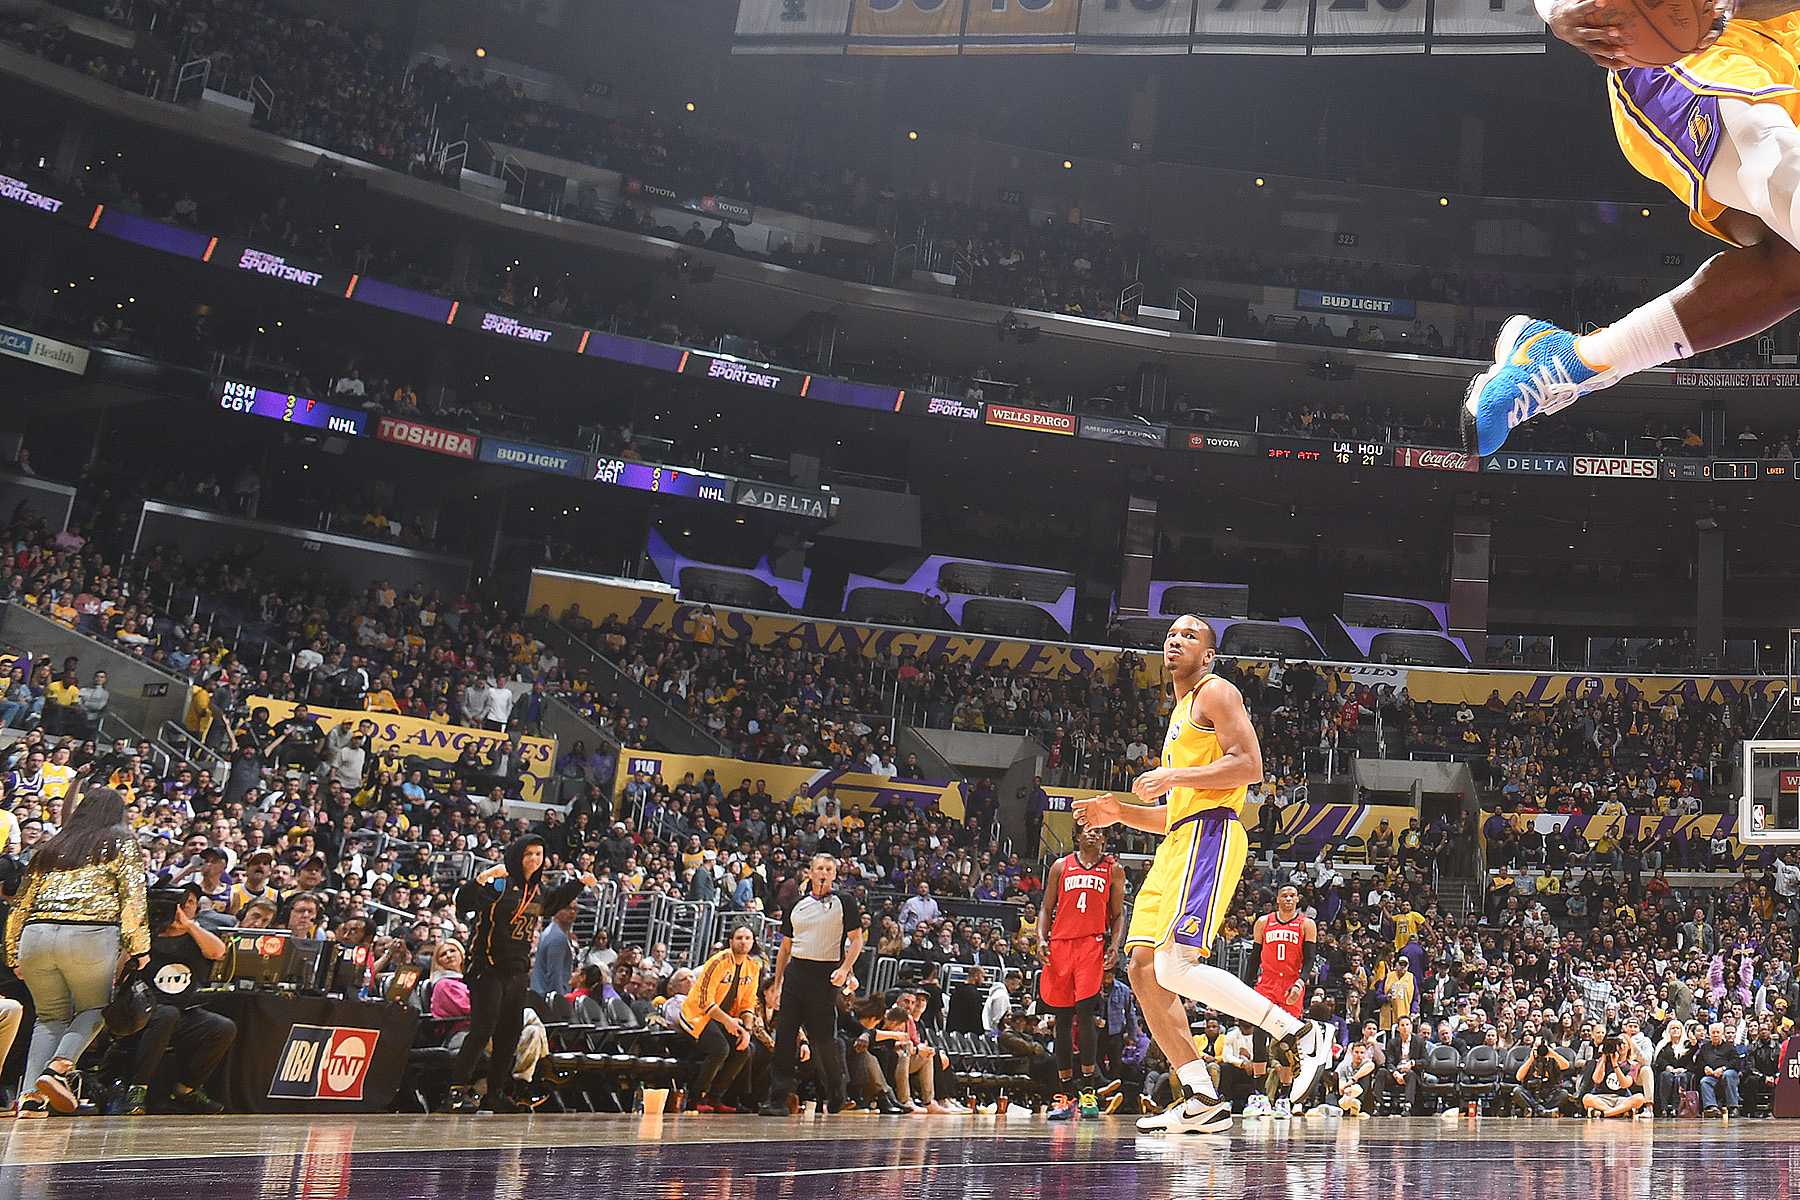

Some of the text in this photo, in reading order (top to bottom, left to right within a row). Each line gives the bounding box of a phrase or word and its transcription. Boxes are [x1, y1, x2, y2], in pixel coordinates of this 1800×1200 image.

[238, 254, 324, 287] SPORTSNET
[1321, 295, 1391, 312] BUD LIGHT
[480, 317, 553, 344] SPORTSNET
[33, 341, 76, 366] Health
[708, 364, 782, 390] SPORTSNET
[1676, 373, 1698, 387] NEED
[1698, 373, 1750, 387] ASSISTANCE?
[1751, 373, 1770, 387] TEXT
[223, 380, 257, 400] NSH
[220, 394, 255, 414] CGY
[286, 394, 298, 409] 3
[306, 399, 316, 413] F
[282, 407, 294, 423] 2
[992, 408, 1071, 429] WELLS FARGO
[327, 415, 359, 435] NHL
[1084, 424, 1127, 438] AMERICAN
[380, 418, 474, 456] TOSHIBA
[1206, 436, 1241, 448] TOYOTA
[1268, 447, 1375, 466] 3PT ATT 16 21
[1333, 440, 1384, 457] LAL HOU
[496, 447, 568, 470] BUD LIGHT
[596, 457, 626, 474] CAR
[1418, 448, 1469, 471] Coca-Cola
[1506, 457, 1568, 473] DELTA
[1574, 457, 1656, 477] STAPLES
[593, 469, 619, 484] ARI
[1728, 463, 1749, 478] 71
[698, 485, 726, 502] NHL
[762, 490, 825, 514] DELTA
[633, 759, 655, 774] 114
[1048, 797, 1067, 811] 115
[1064, 874, 1107, 893] ROCKETS
[1076, 891, 1087, 914] 4
[511, 914, 535, 942] 24
[1264, 929, 1300, 944] ROCKETS
[1276, 942, 1286, 961] 0
[279, 1039, 320, 1084] NBA
